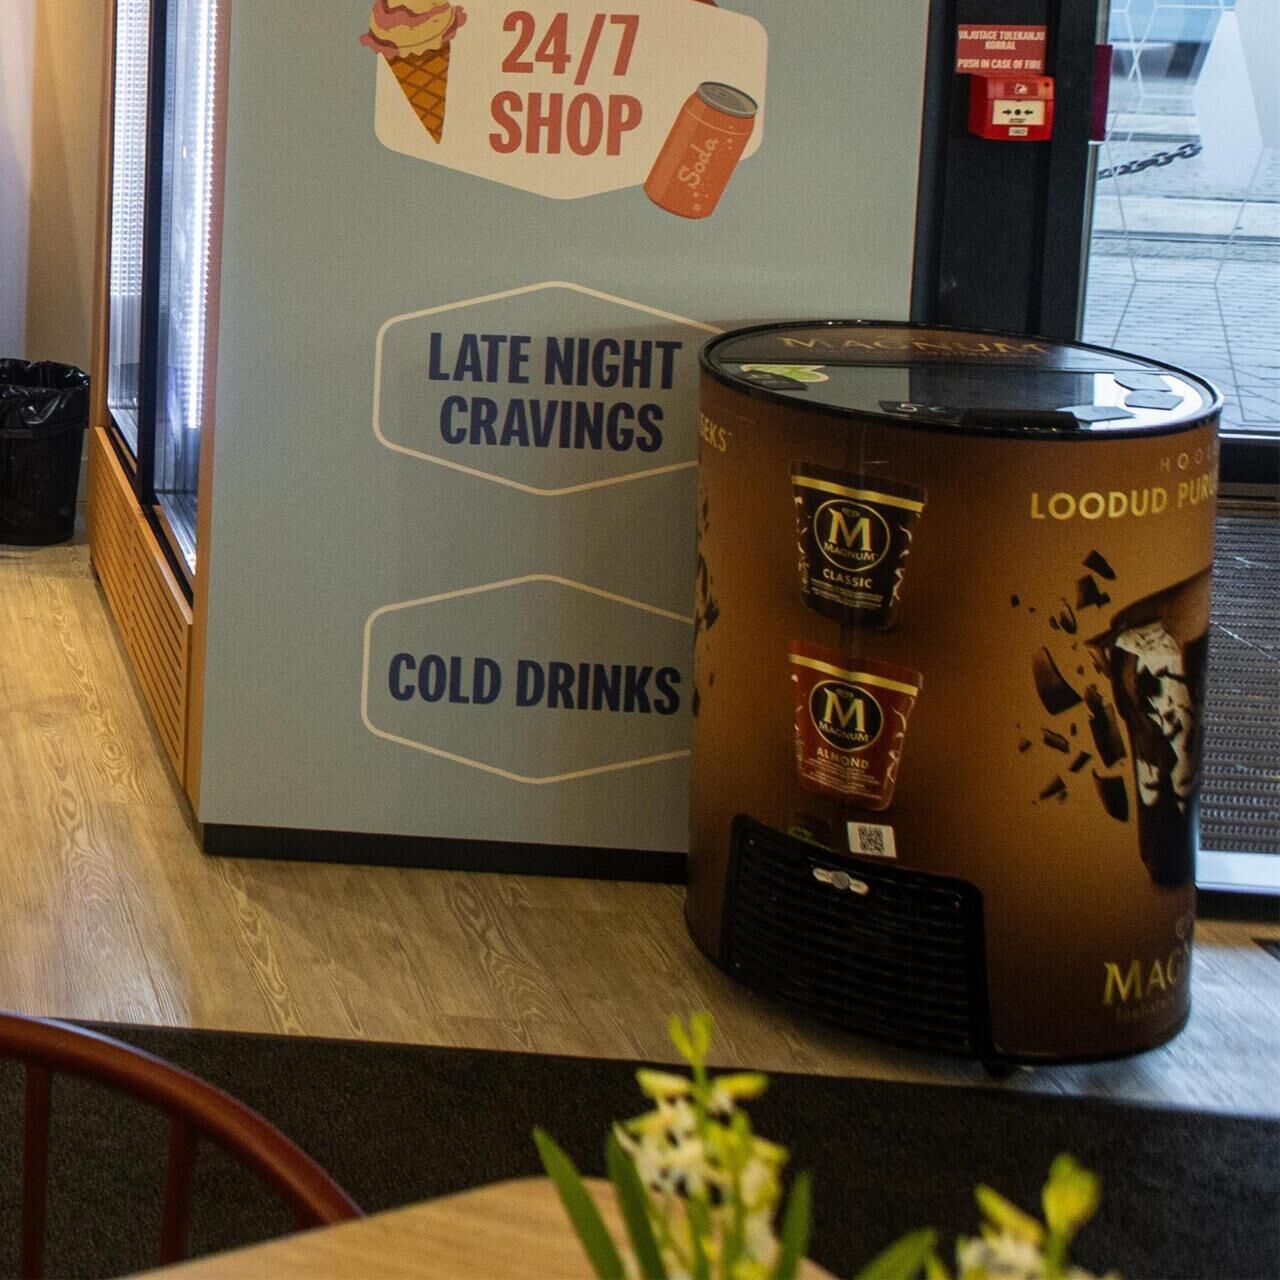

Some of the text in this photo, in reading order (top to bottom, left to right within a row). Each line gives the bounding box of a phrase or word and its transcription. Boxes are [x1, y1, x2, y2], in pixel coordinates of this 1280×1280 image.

[501, 10, 640, 86] 24/7
[957, 59, 1042, 70] PUSH IN CASE OF FIRE
[488, 90, 643, 156] SHOP
[677, 136, 720, 189] Soda
[428, 332, 682, 389] LATE NIGHT
[439, 395, 665, 453] CRAVINGS
[1029, 487, 1169, 521] LOODUD
[823, 541, 877, 562] MAGNUM
[828, 507, 873, 552] M
[822, 568, 873, 589] CLASSIC
[388, 653, 681, 716] COLD DRINKS
[818, 720, 869, 743] MAGNUM
[823, 687, 866, 733] M
[816, 746, 870, 770] ALMOND
